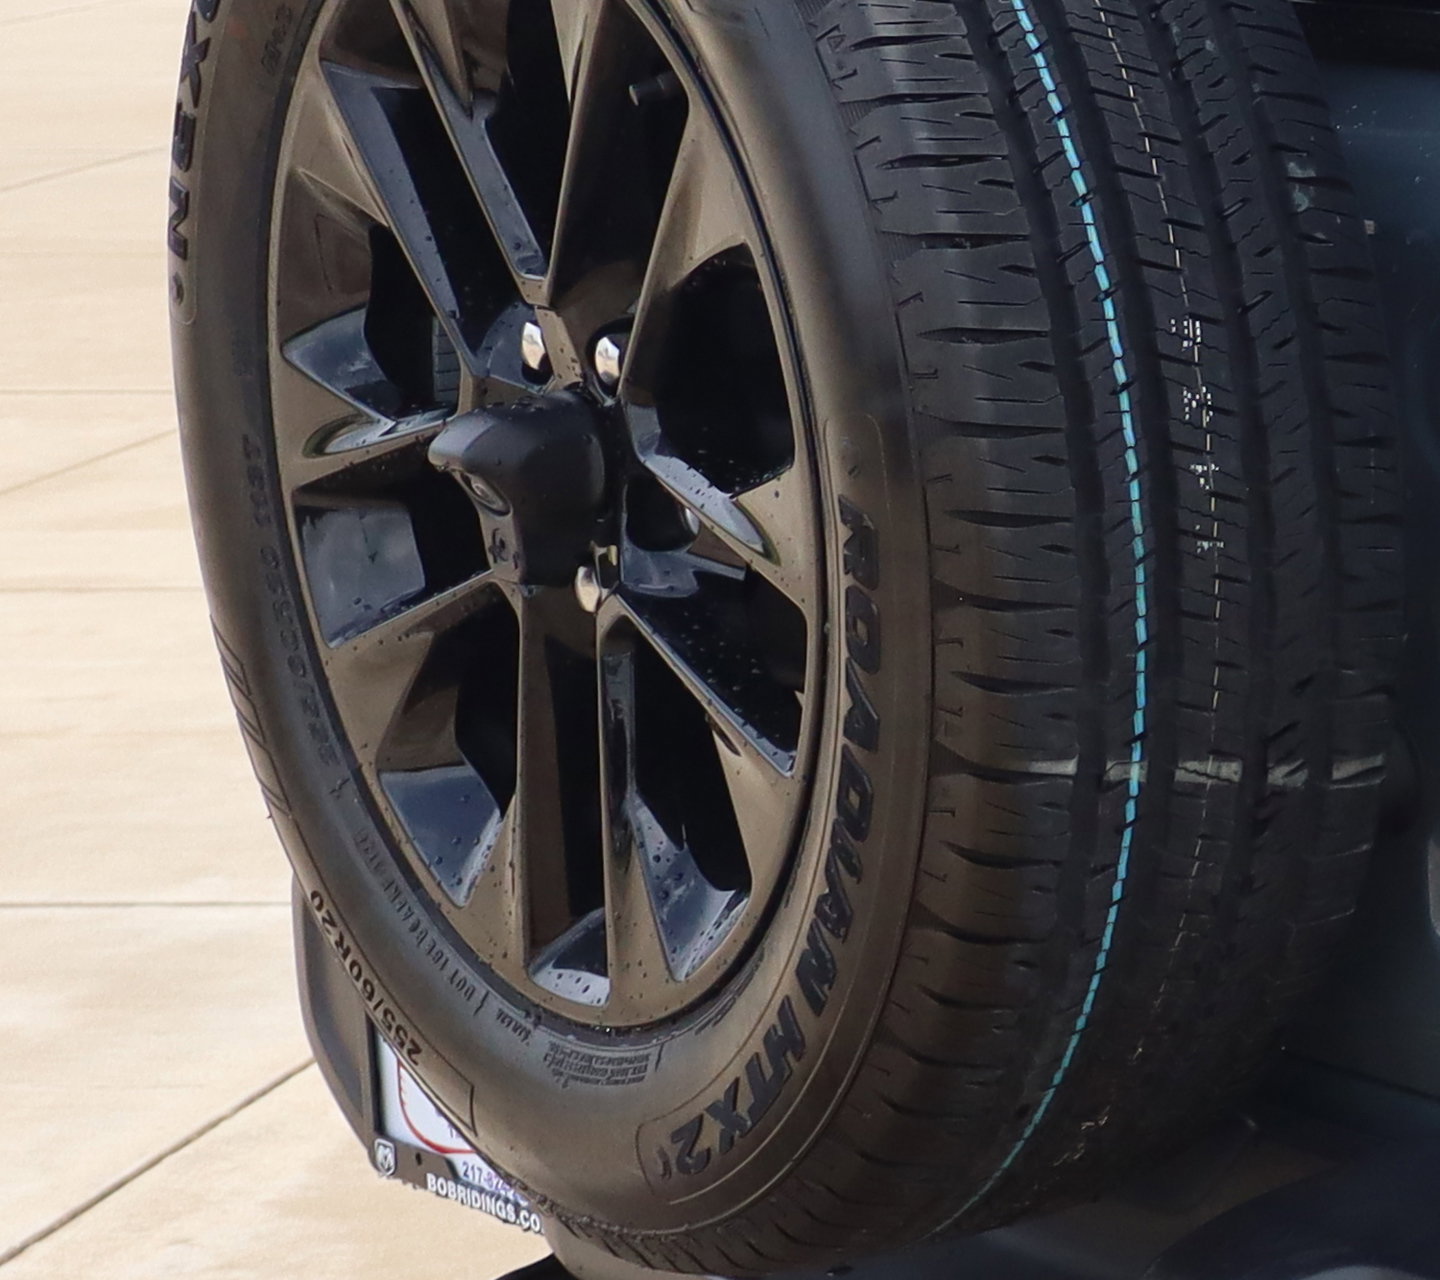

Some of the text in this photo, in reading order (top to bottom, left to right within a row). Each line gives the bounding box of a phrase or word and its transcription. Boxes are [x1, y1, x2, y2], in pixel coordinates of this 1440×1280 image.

[794, 494, 881, 1019] ROADIAN
[308, 889, 424, 1067] 255/60R20
[425, 1172, 546, 1236] BOBRIDINGS.CO
